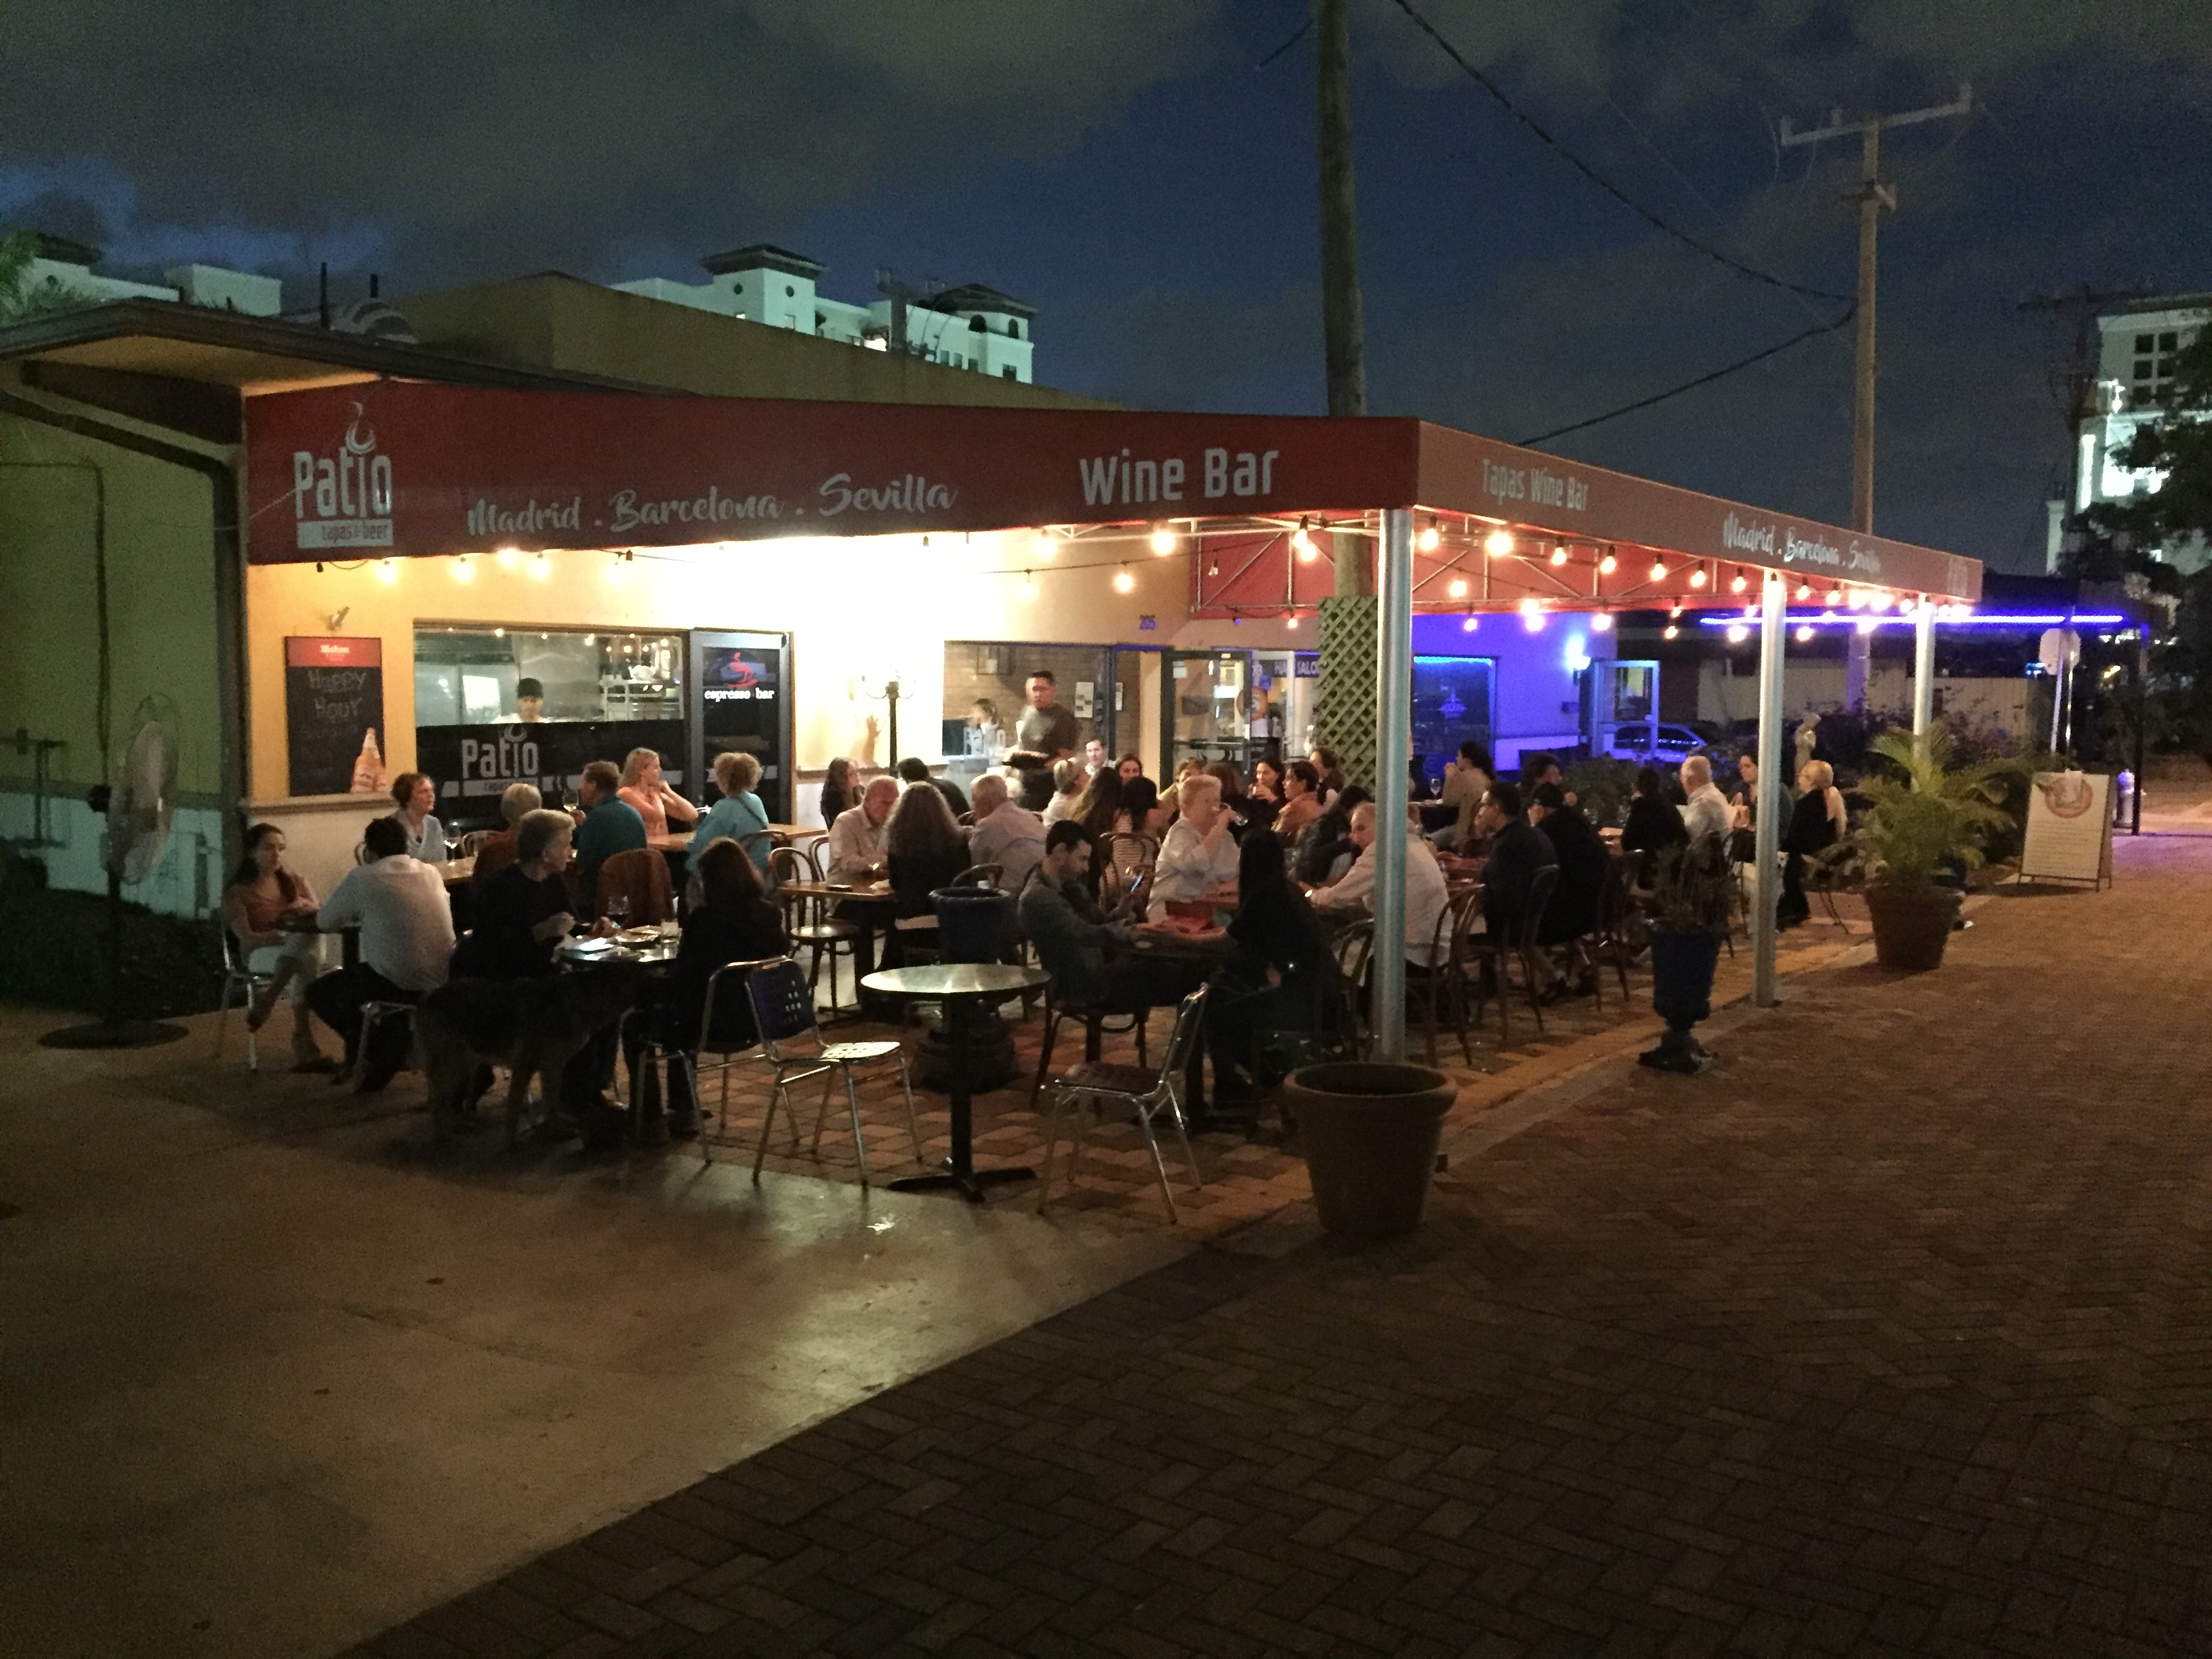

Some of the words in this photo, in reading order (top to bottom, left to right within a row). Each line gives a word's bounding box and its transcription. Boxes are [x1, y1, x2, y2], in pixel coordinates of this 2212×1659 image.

[293, 446, 392, 520] Patio
[1080, 448, 1185, 506] Wine
[1204, 448, 1279, 498] Bar
[1482, 458, 1524, 506] Tapas
[1530, 466, 1563, 507] Wine
[1567, 476, 1589, 511] Bar
[468, 496, 581, 536] Madrid
[609, 487, 785, 532] Barcelona
[818, 473, 958, 516] Sevilla
[322, 525, 352, 544] tapas
[363, 520, 388, 539] beer
[1723, 510, 1776, 556] Madrid
[704, 690, 751, 702] espresso
[755, 687, 775, 699] bar
[461, 737, 539, 779] Patio
